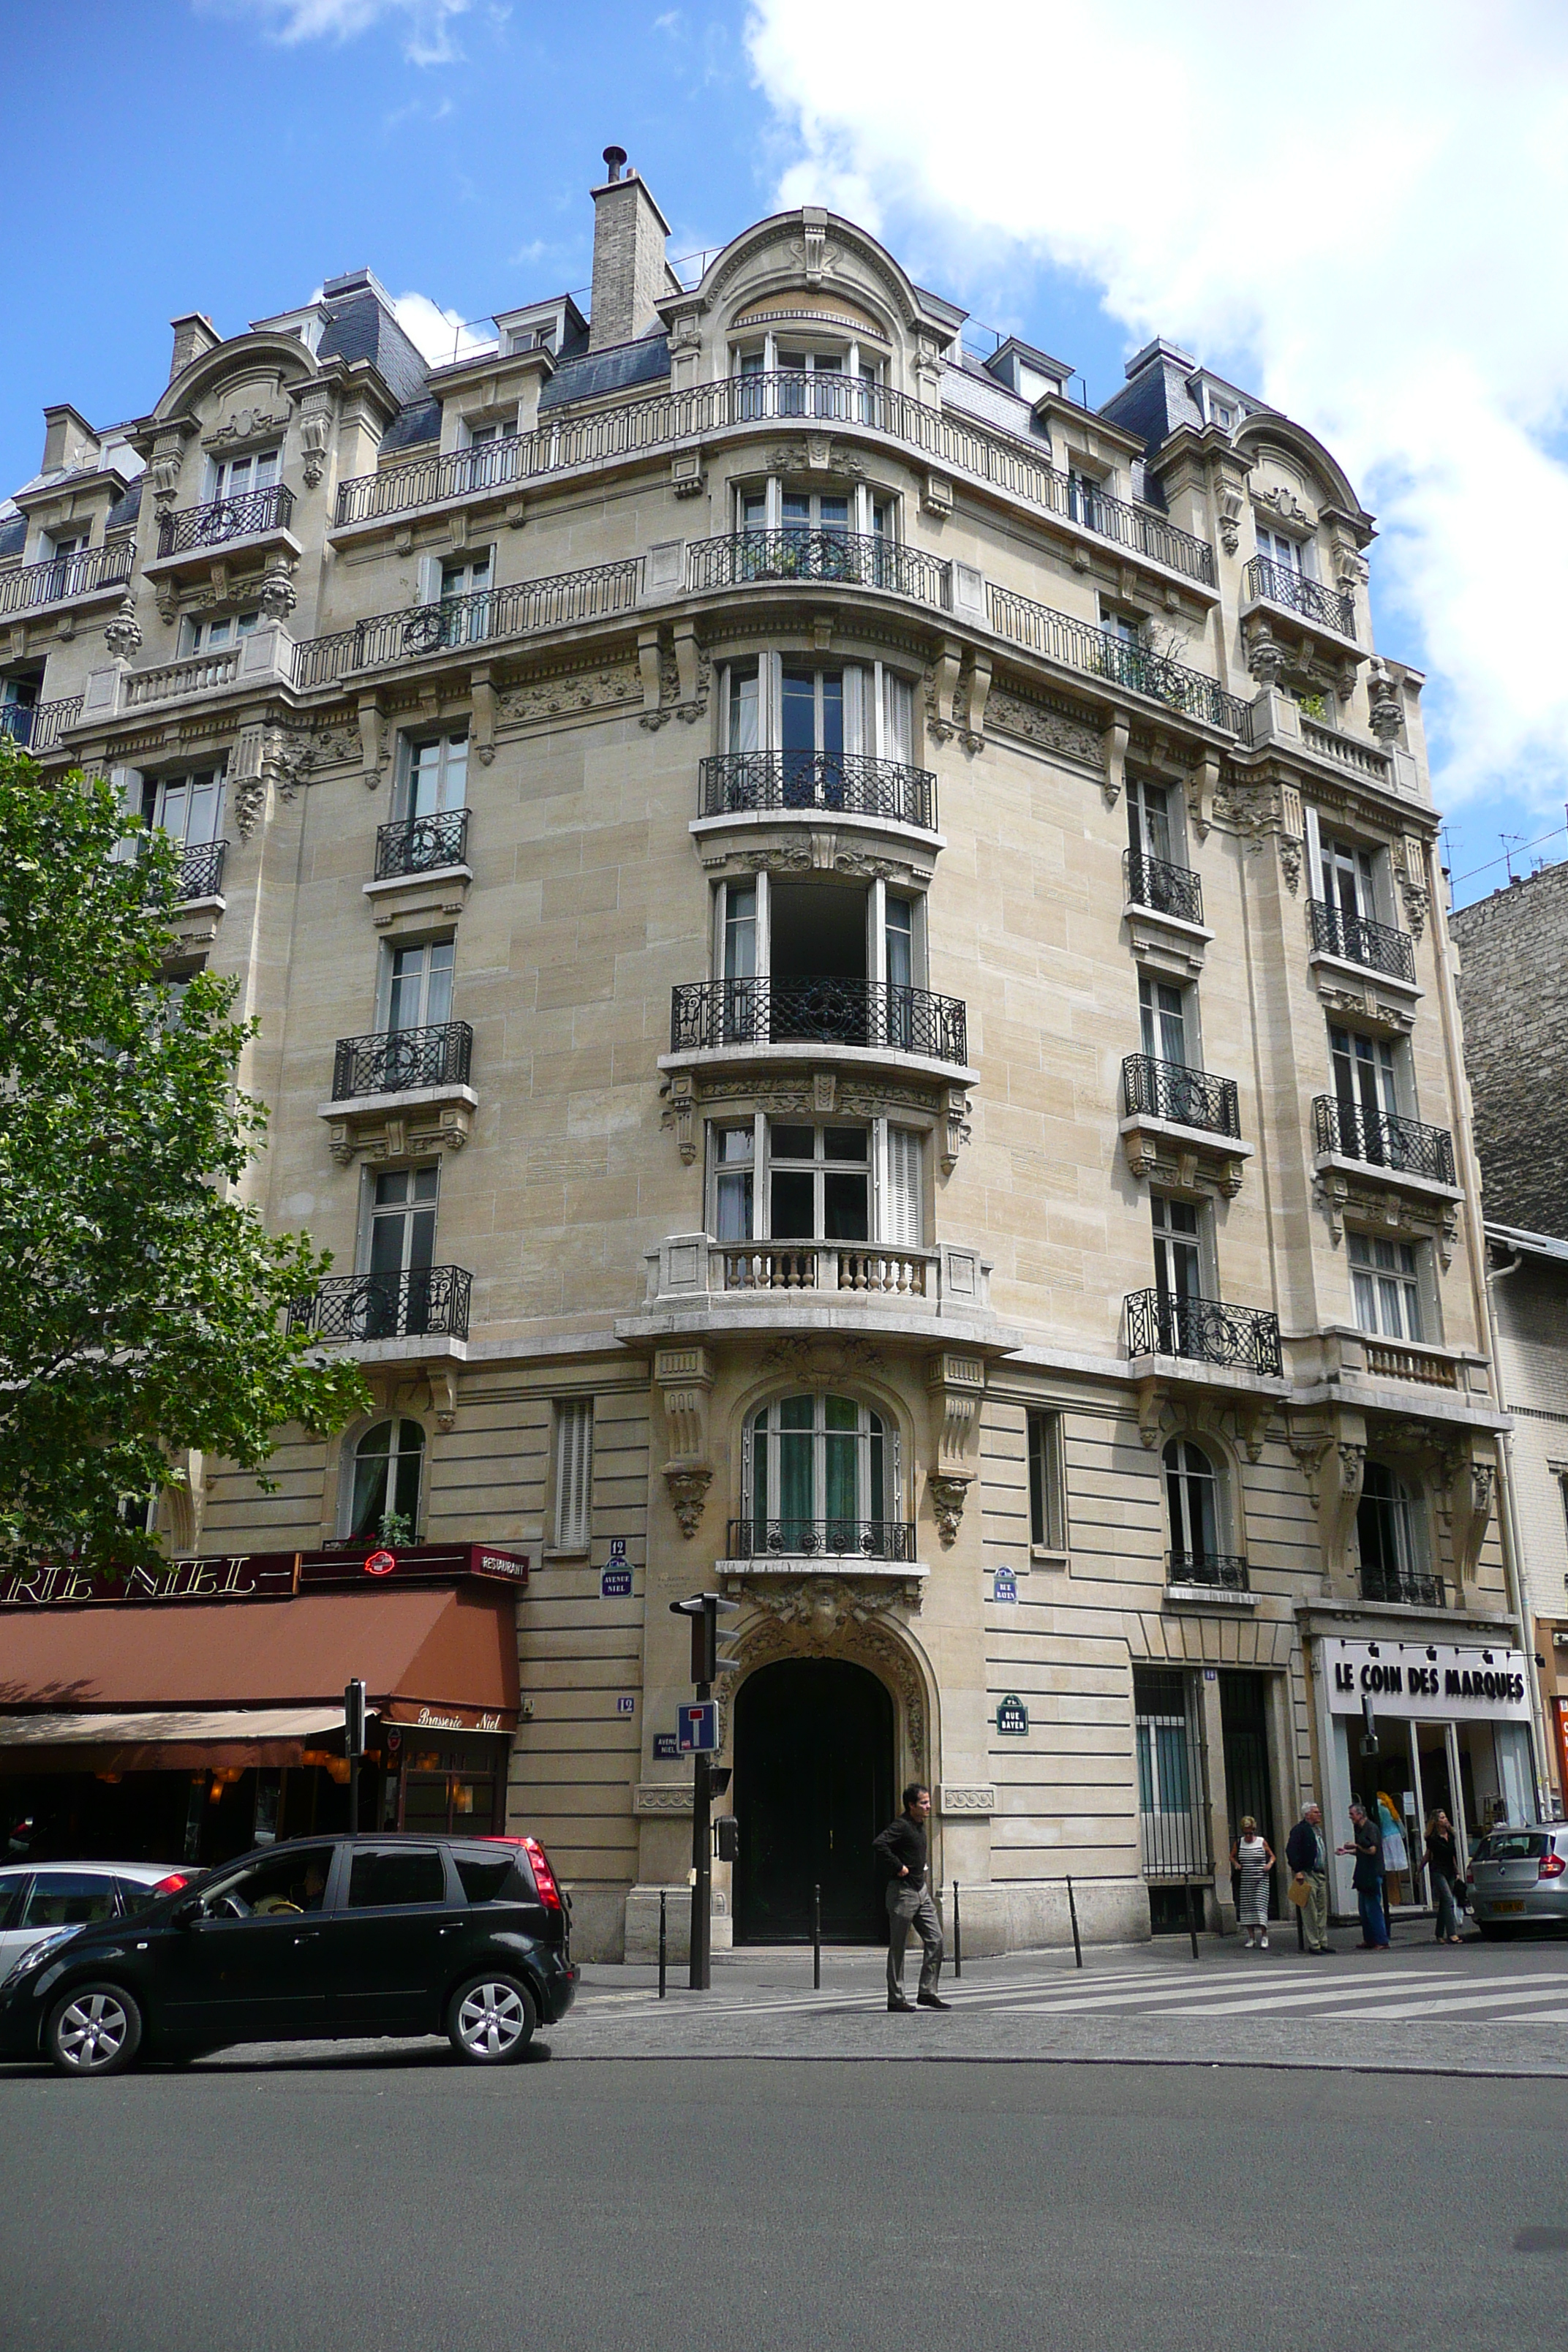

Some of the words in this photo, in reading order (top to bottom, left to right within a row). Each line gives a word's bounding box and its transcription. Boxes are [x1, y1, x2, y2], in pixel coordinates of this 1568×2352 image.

[612, 1541, 624, 1554] 12
[482, 1556, 524, 1576] RESTAURANT
[0, 1564, 93, 1602] RIE
[124, 1557, 256, 1597] NIEL
[604, 1575, 630, 1583] AVENUE
[1335, 1662, 1354, 1691] LE
[1360, 1664, 1403, 1693] COIN
[1407, 1667, 1439, 1696] DES
[1444, 1669, 1525, 1700] MARQUES
[620, 1699, 633, 1712] 12
[418, 1707, 464, 1729] Brasserie
[475, 1712, 502, 1730] Niel
[1005, 1711, 1019, 1720] RUE
[1001, 1721, 1024, 1730] BAYEN
